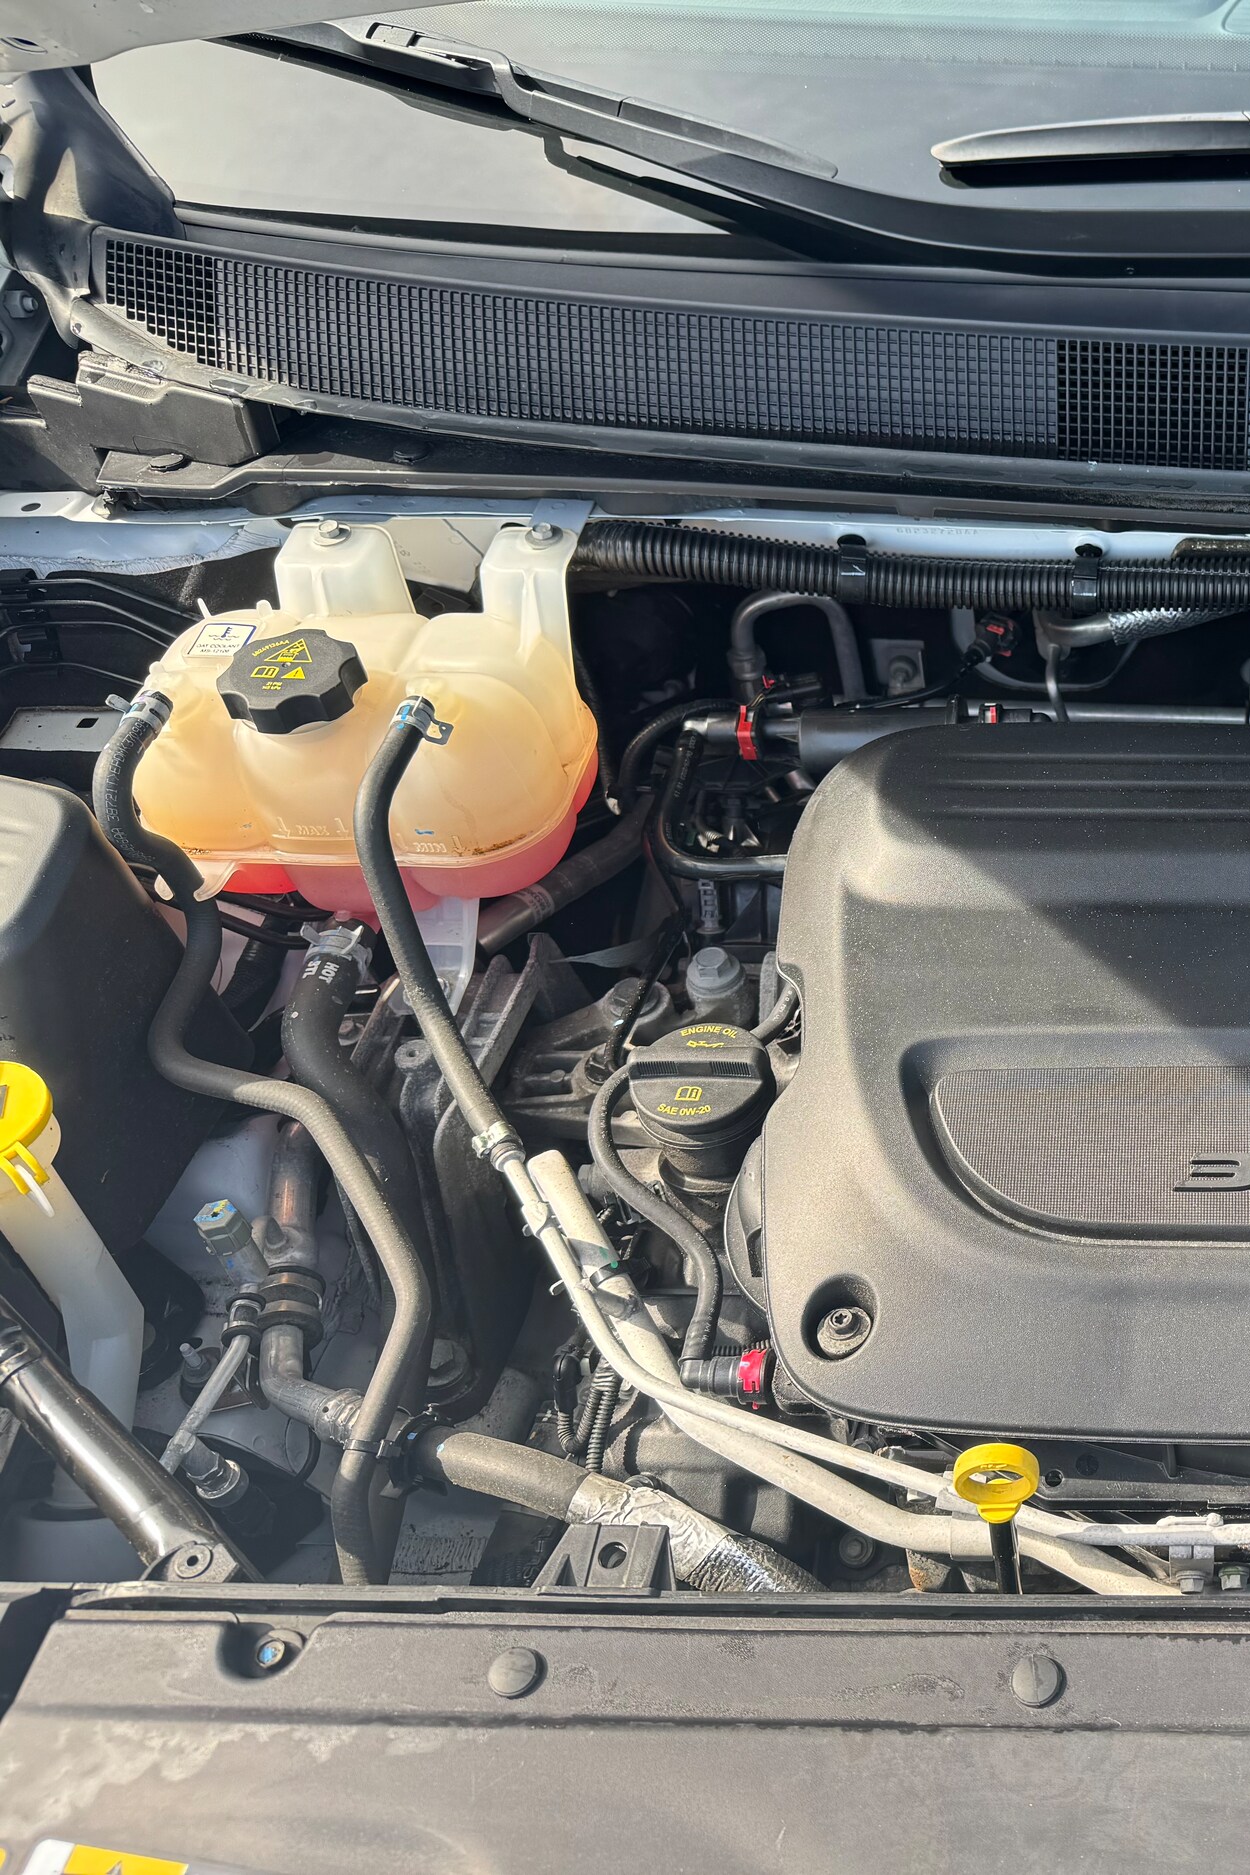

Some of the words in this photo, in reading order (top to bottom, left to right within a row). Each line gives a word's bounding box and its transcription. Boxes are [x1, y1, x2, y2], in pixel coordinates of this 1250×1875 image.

[295, 824, 331, 836] MAX
[413, 841, 448, 853] MIN
[318, 961, 340, 984] HOT
[679, 1024, 722, 1038] ENGINE
[722, 1028, 738, 1039] OIL
[656, 1103, 677, 1115] SAE
[679, 1104, 711, 1116] 0W-20
